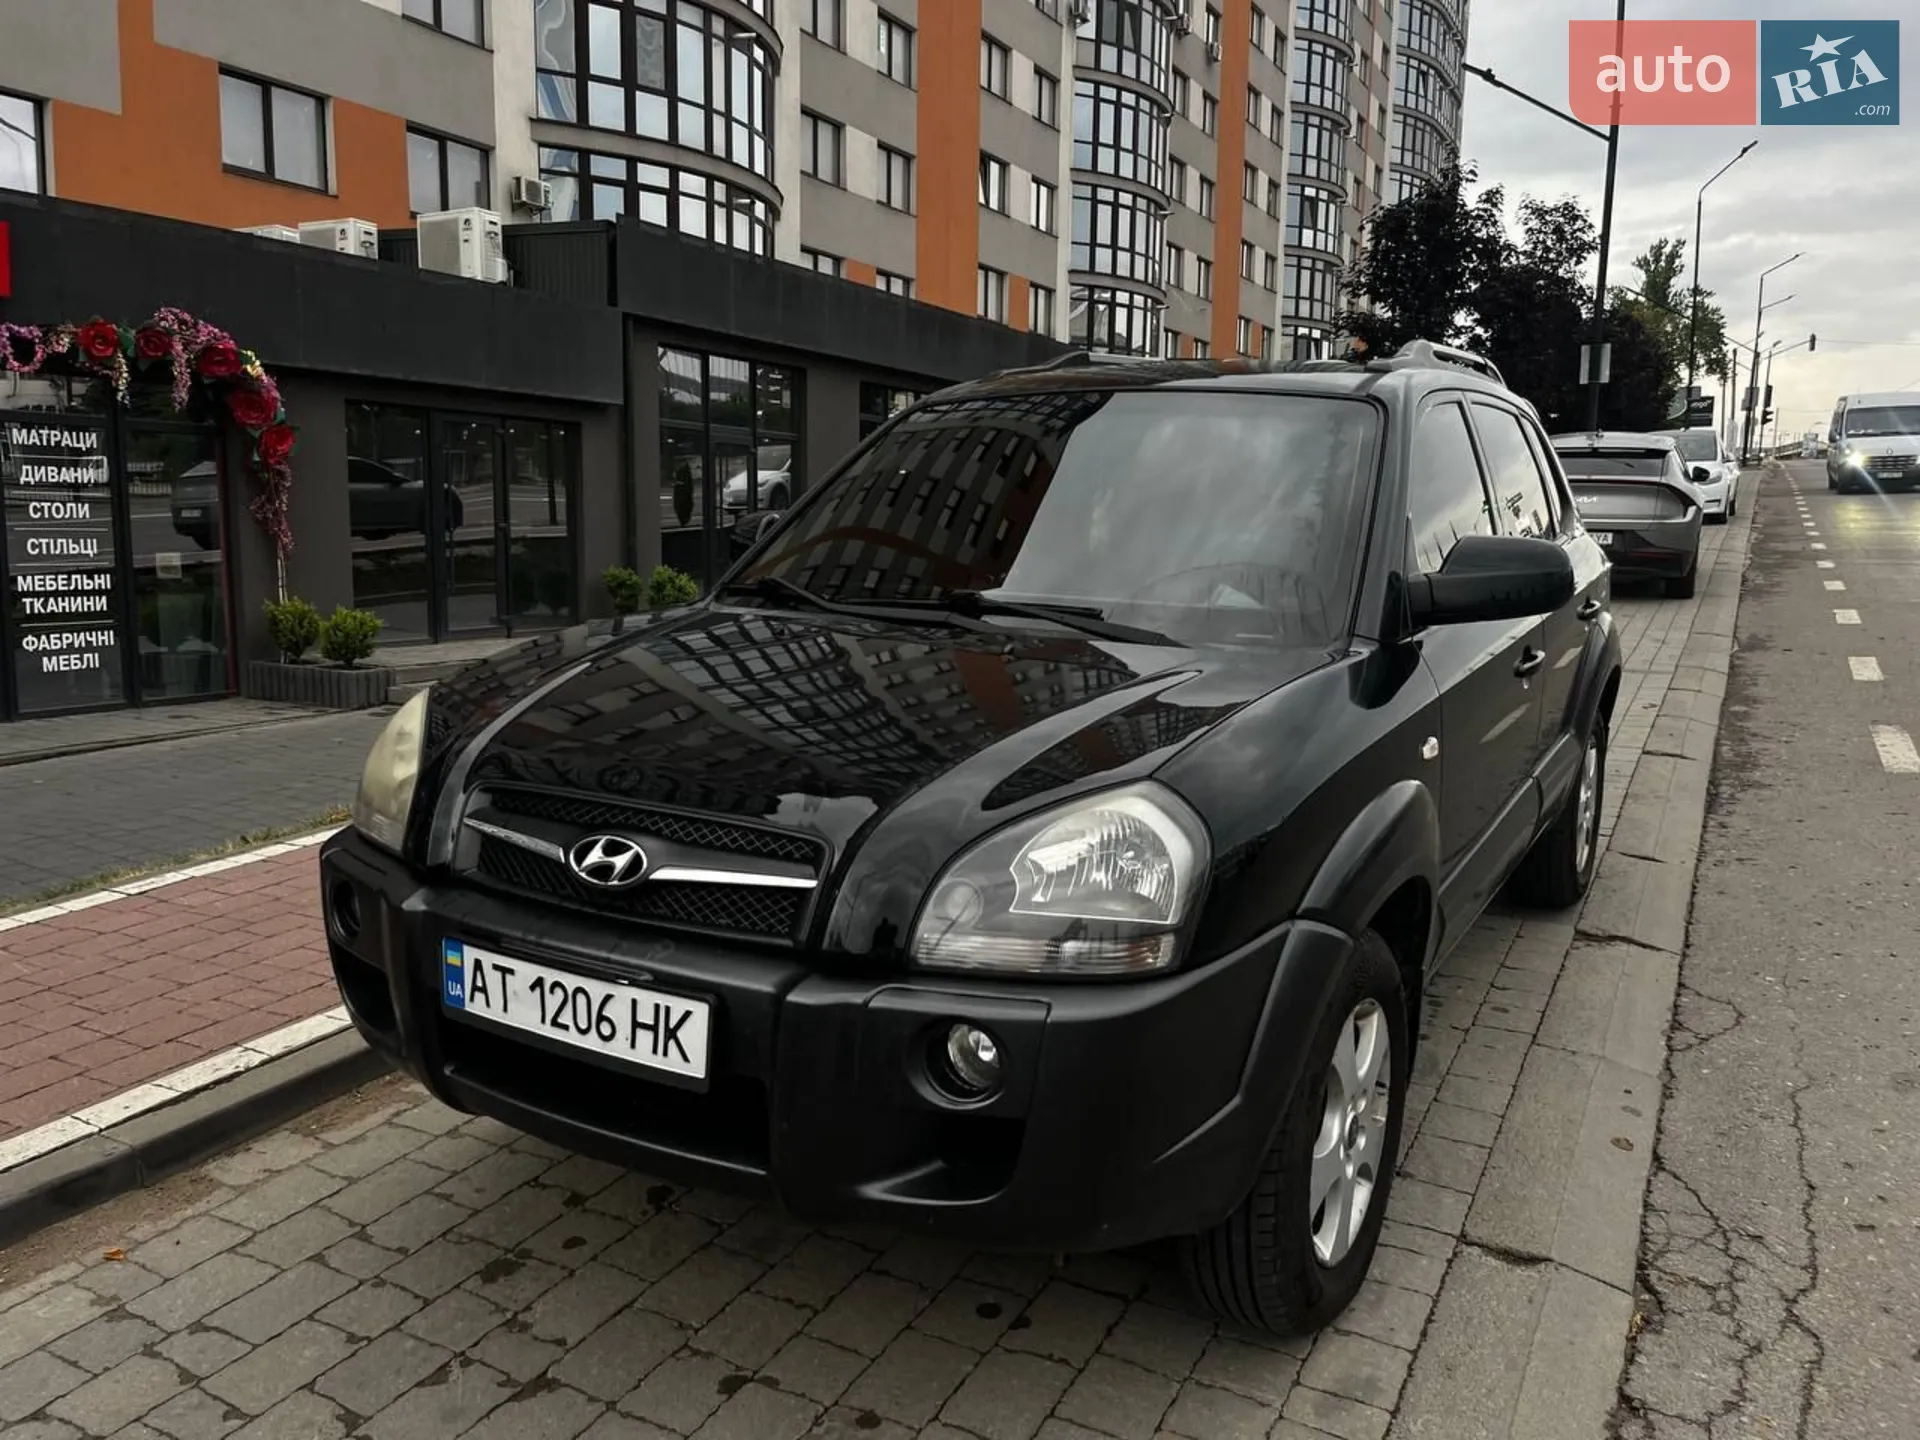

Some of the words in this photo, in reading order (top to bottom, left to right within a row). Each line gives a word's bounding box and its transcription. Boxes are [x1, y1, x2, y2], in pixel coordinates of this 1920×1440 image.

[12, 427, 97, 451] МАТРАЦИ
[19, 464, 95, 485] ДИВАНИ
[28, 501, 90, 519] СТОЛИ
[26, 537, 98, 557] СТІЛЬЦІ
[17, 573, 111, 592] МЕБЕЛЬНІ
[21, 595, 108, 614] ТКАНИНИ
[22, 629, 115, 652] ФАБРИЧНІ
[42, 652, 100, 673] МЕБЛІ
[448, 980, 464, 999] UA
[469, 957, 516, 1013] AT
[528, 975, 617, 1043] 1206
[629, 997, 694, 1064] HK
